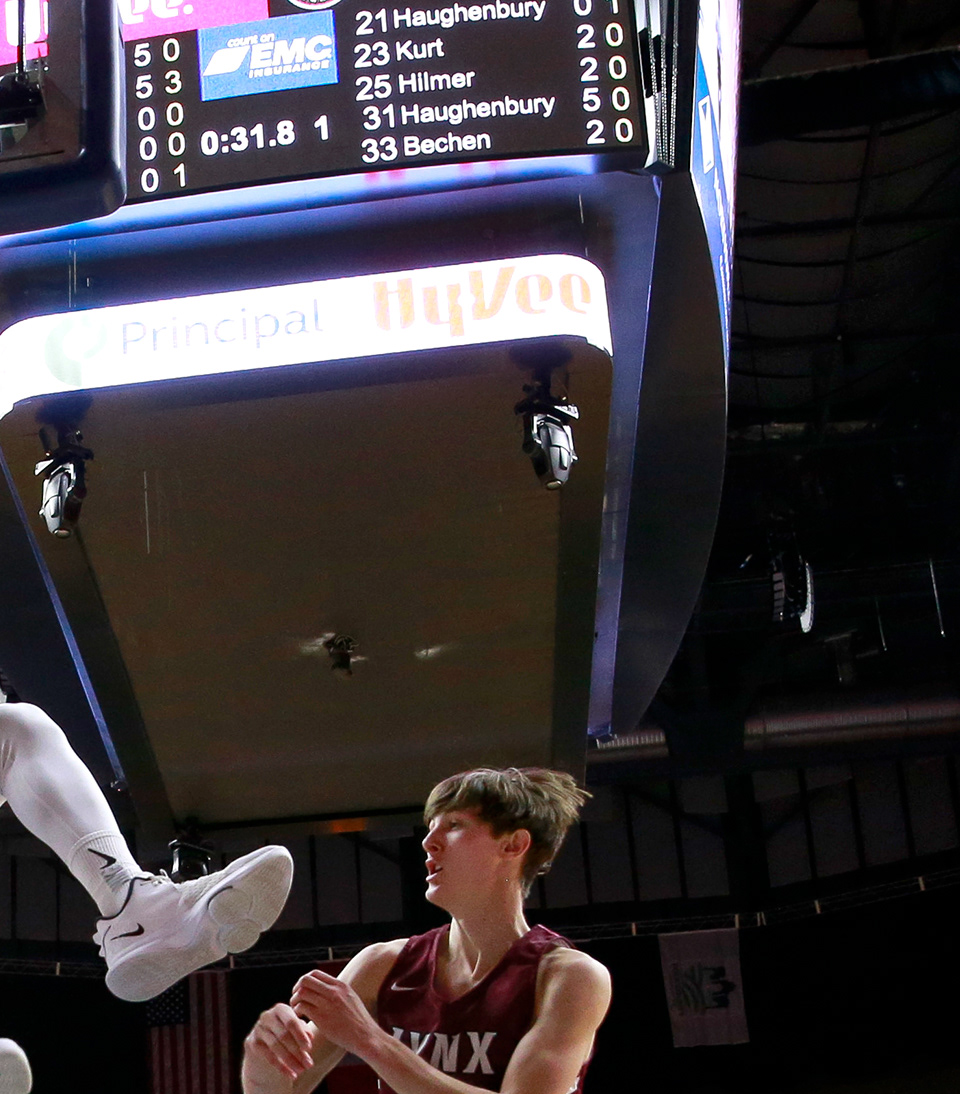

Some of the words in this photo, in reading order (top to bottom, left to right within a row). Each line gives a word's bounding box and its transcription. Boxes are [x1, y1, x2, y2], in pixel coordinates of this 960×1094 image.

[355, 8, 388, 35] 21
[393, 0, 547, 29] Haughenbury
[134, 43, 151, 67] 5
[162, 38, 180, 62] 0
[227, 35, 258, 48] count
[260, 33, 275, 43] on
[250, 35, 333, 69] EMC
[353, 41, 390, 68] 23
[395, 37, 445, 62] Kurt
[576, 24, 596, 49] 2
[605, 22, 624, 47] 0
[135, 75, 153, 99] 5
[164, 70, 182, 94] 3
[248, 60, 330, 79] INSURANCE
[355, 74, 392, 101] 25
[398, 70, 476, 94] Hilmer
[579, 56, 599, 82] 2
[608, 55, 627, 80] 0
[137, 107, 156, 131] 0
[166, 102, 184, 126] 0
[362, 103, 395, 131] 31
[400, 95, 556, 125] Haughenbury
[582, 87, 601, 112] 5
[611, 86, 630, 112] 0
[139, 136, 157, 161] 0
[168, 132, 186, 157] 0
[200, 119, 296, 156] 0:31.8
[313, 114, 329, 141] 1
[361, 135, 398, 164] 33
[403, 132, 492, 157] Bechen
[585, 119, 605, 145] 2
[614, 118, 634, 143] 0
[141, 168, 159, 192] 0
[173, 163, 186, 188] 1
[122, 298, 324, 355] Principal
